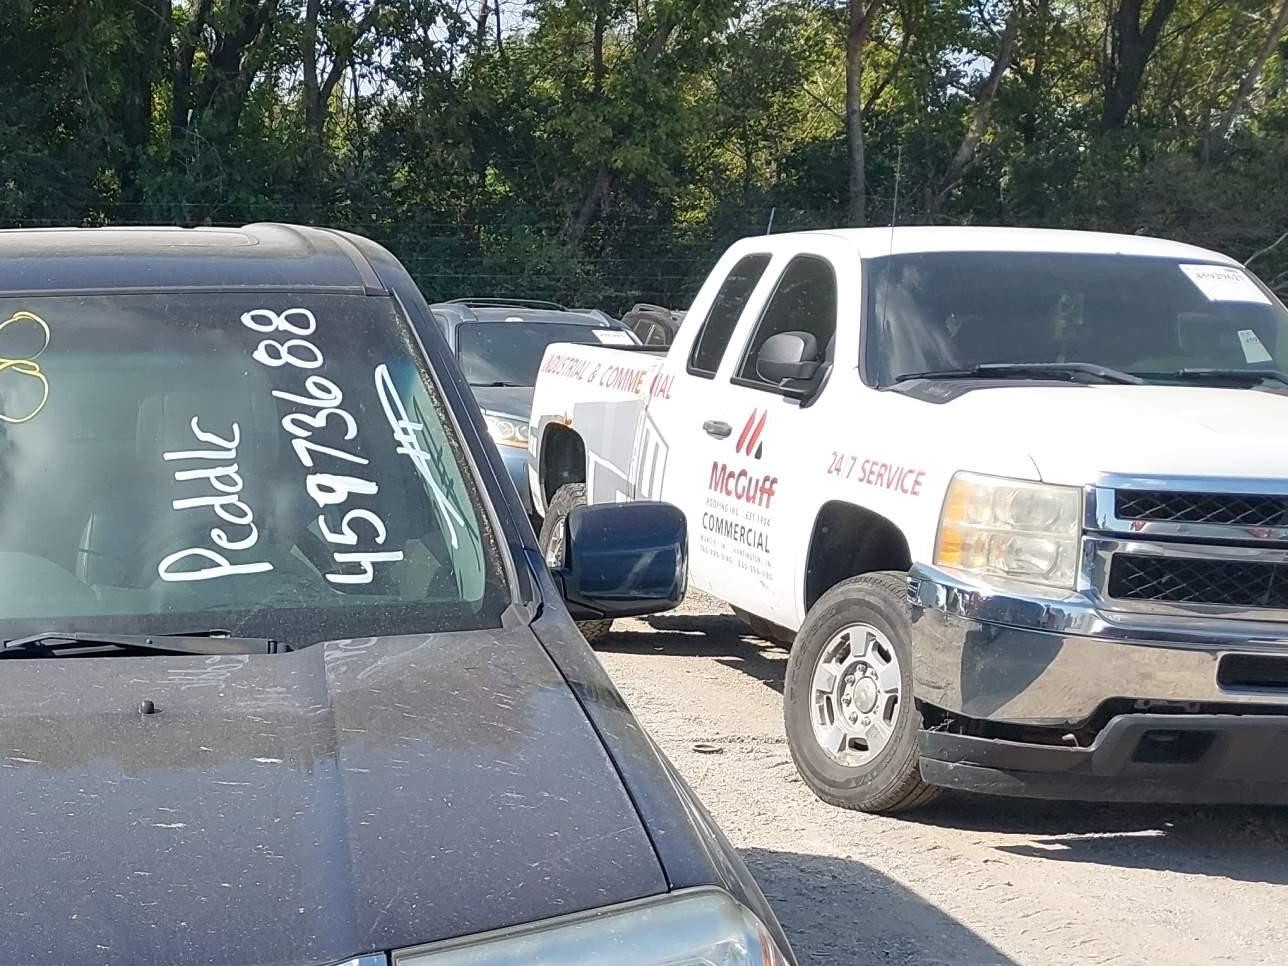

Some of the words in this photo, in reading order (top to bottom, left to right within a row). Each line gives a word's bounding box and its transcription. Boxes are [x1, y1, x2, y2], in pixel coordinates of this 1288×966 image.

[240, 307, 404, 585] 45973688
[708, 460, 779, 509] McGuff
[858, 459, 926, 496] SERVICE
[702, 511, 771, 554] COMMERCIAL
